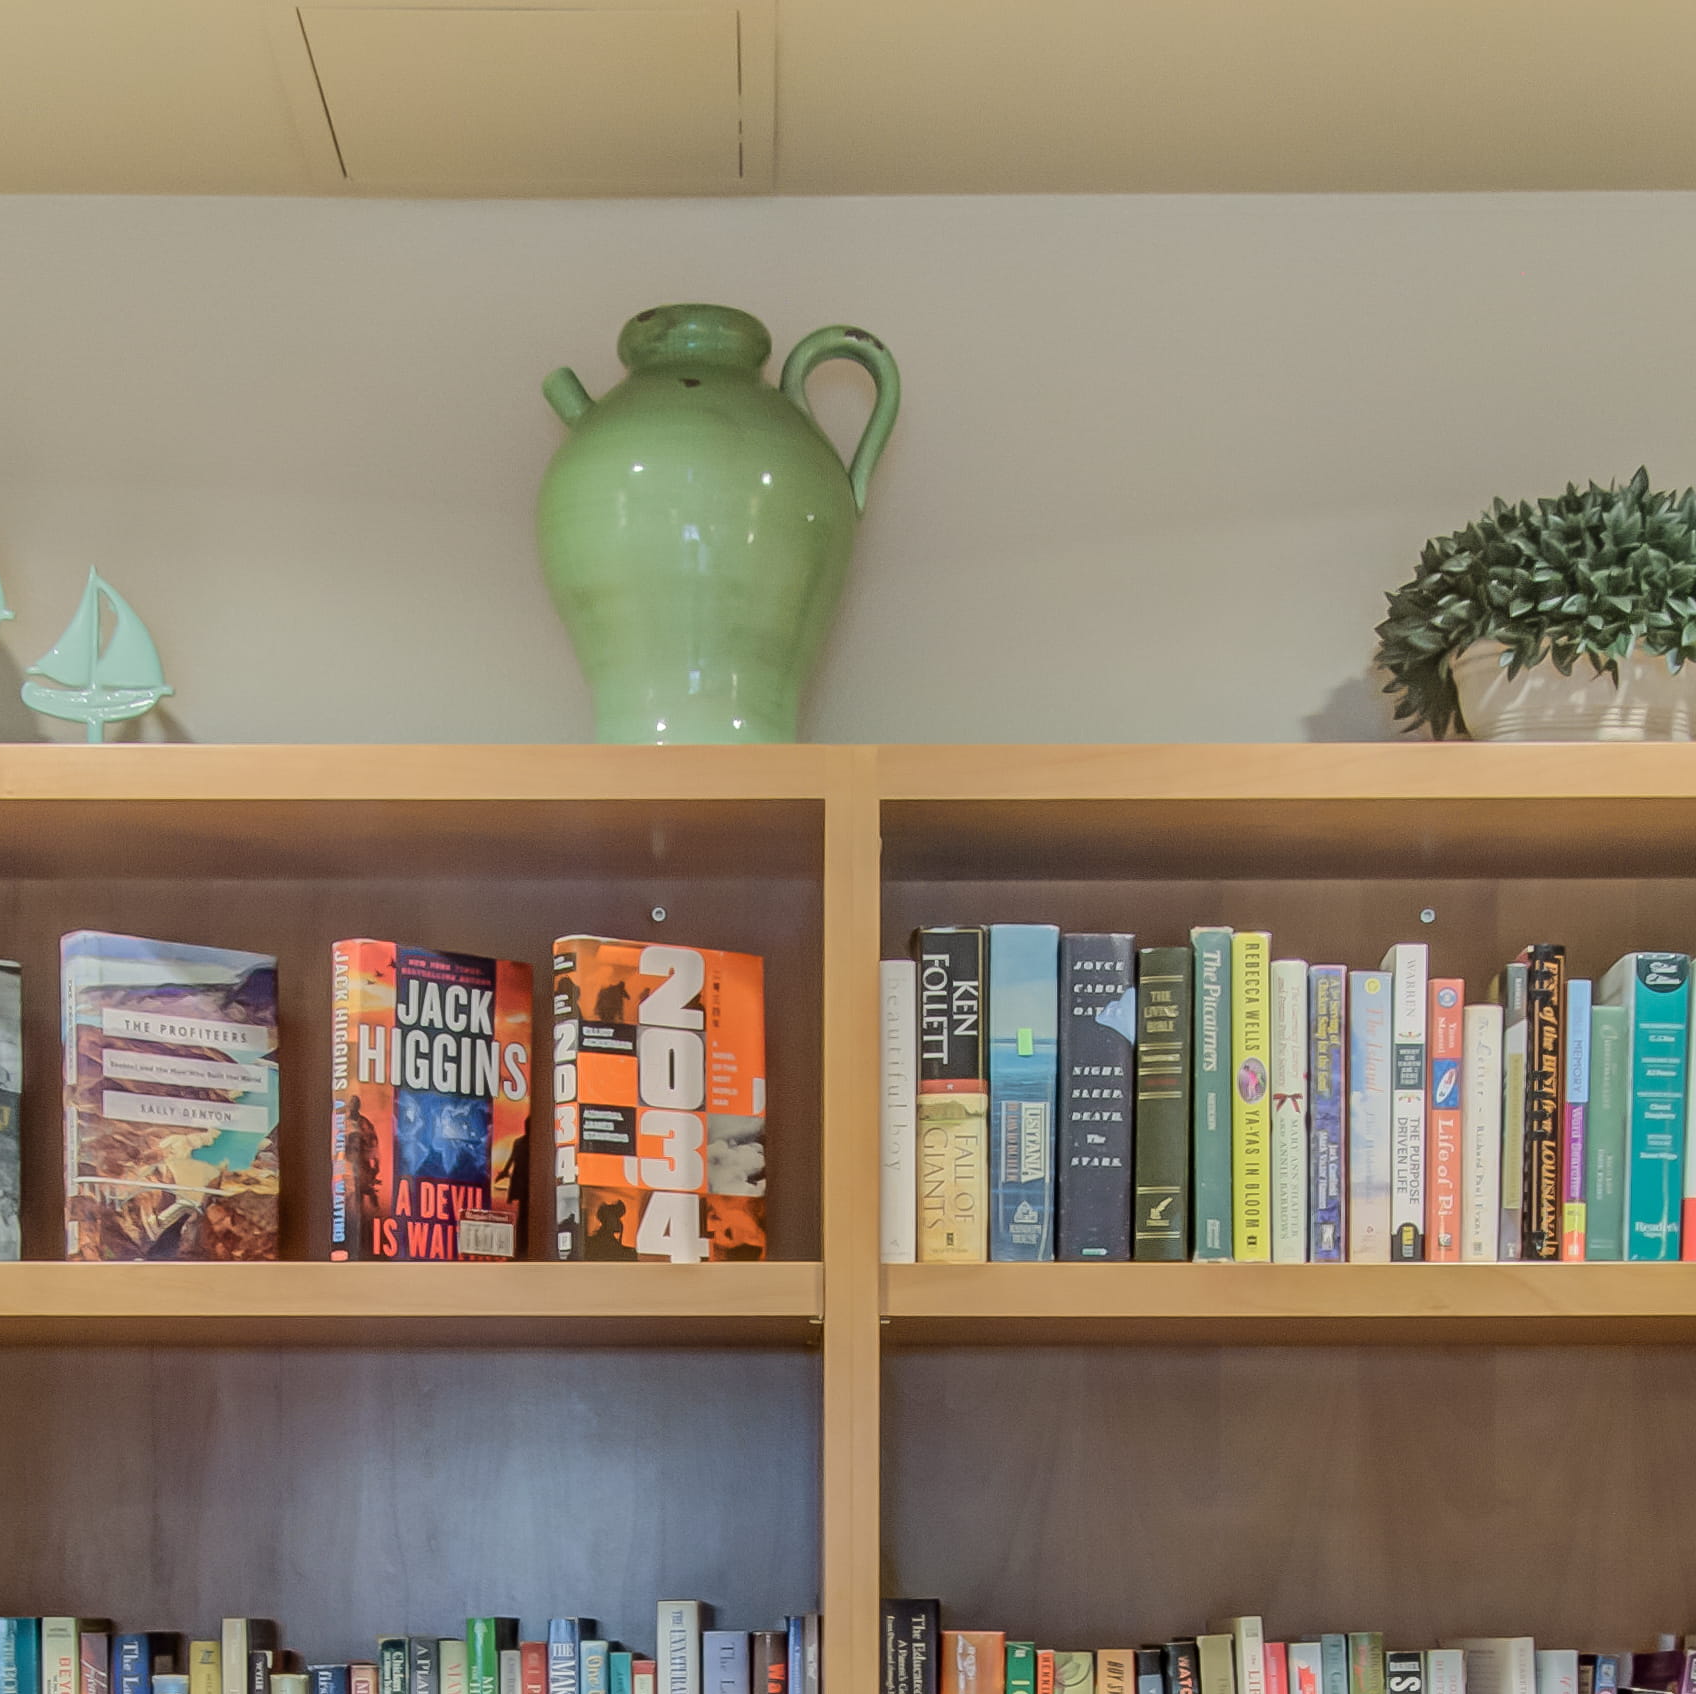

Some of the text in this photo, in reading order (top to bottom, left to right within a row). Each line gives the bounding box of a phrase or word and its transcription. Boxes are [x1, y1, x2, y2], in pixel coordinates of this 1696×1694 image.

[125, 1019, 247, 1043] THE PROFITEERS
[334, 951, 349, 1090] JACK HIGGINS
[397, 979, 493, 1035] JACK
[922, 954, 949, 1064] FOLLETT
[952, 980, 979, 1036] KEN
[1245, 943, 1260, 1051] REBECCA WELLS
[358, 1023, 528, 1101] HIGGINS
[141, 1104, 232, 1121] SALLY DENTON
[924, 1127, 947, 1229] GIANTS
[954, 1135, 977, 1223] FALL OF
[1245, 1110, 1260, 1228] YA-YAS IN BLOOM
[1397, 1118, 1407, 1193] DRIVEN LIFE
[1409, 1118, 1420, 1204] THE PURPOSE
[1438, 1120, 1454, 1216] Life of Pi
[395, 1180, 412, 1216] A
[372, 1218, 398, 1257] IS
[122, 1640, 138, 1671] The
